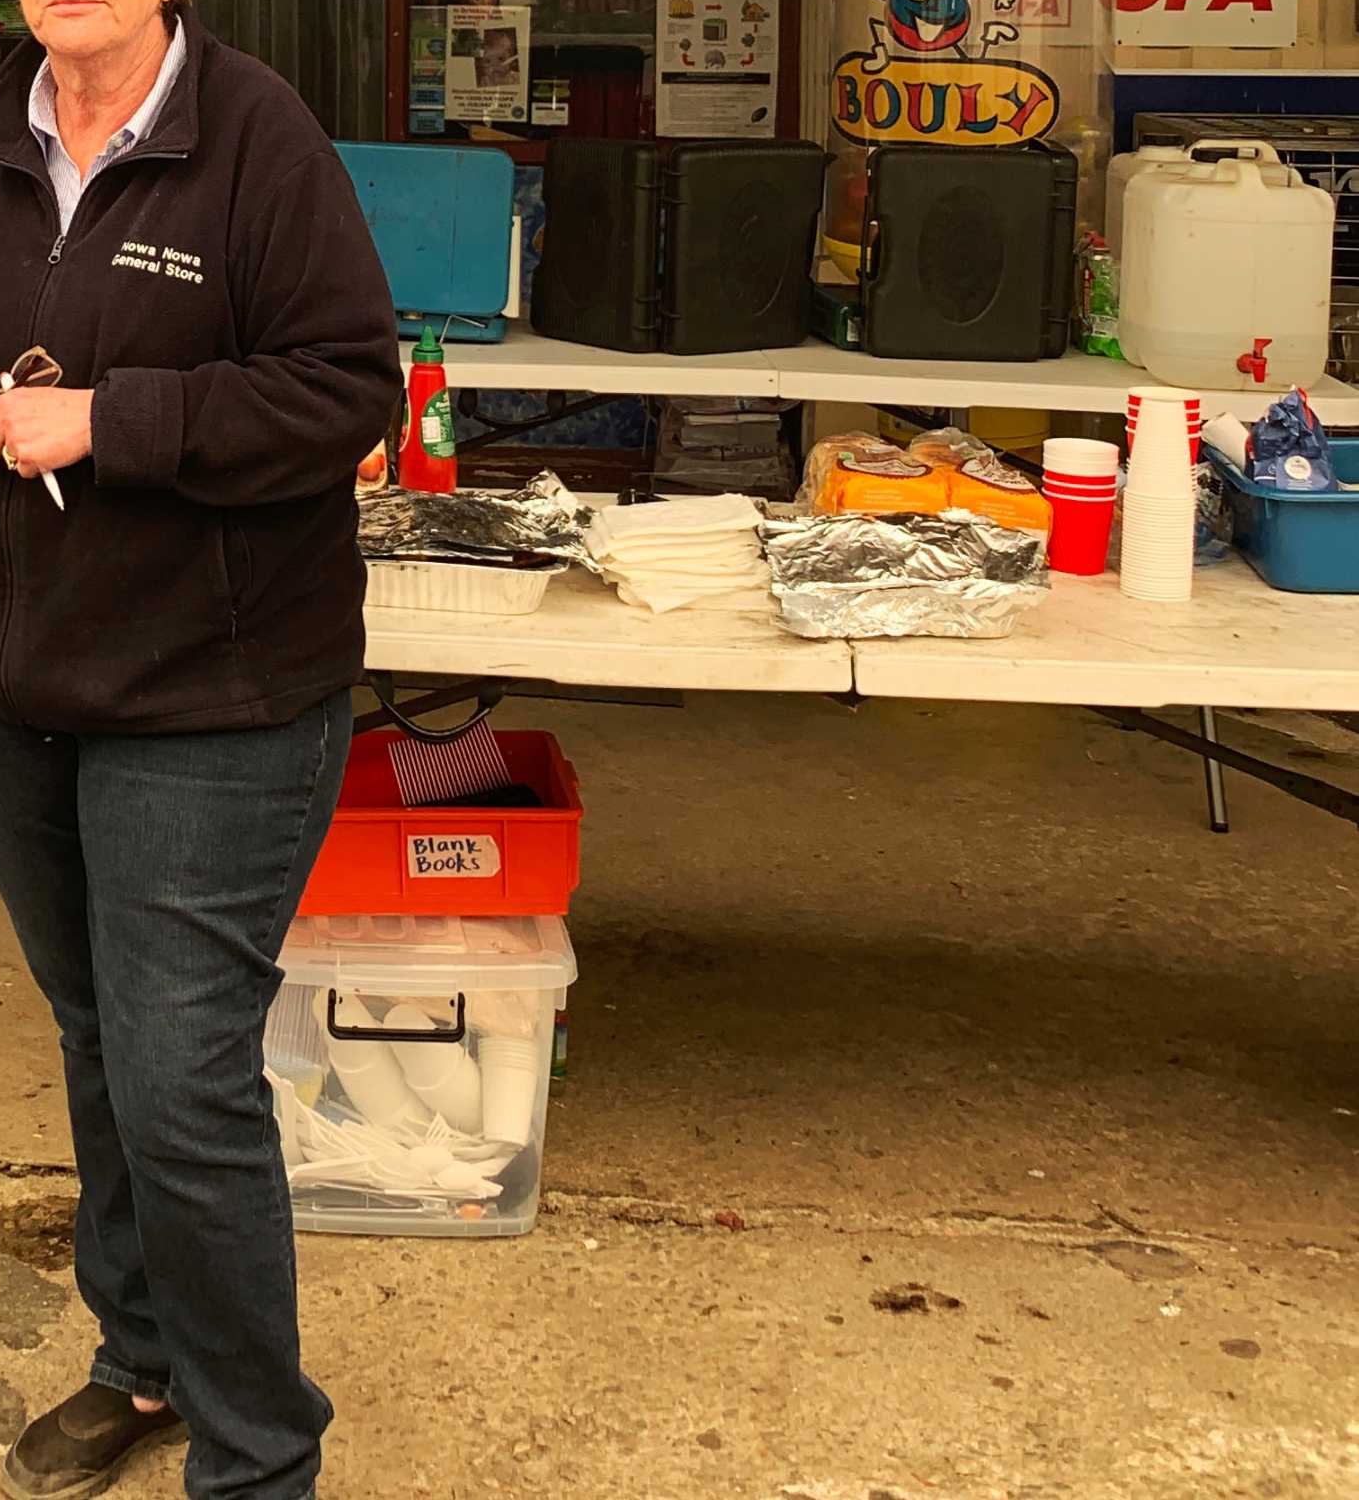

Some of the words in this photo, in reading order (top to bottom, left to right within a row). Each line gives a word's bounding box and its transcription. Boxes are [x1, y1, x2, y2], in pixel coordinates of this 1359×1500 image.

[837, 75, 1048, 136] BOULY
[121, 240, 156, 256] Nowa
[162, 247, 201, 266] Nowa
[111, 254, 160, 273] General
[165, 263, 204, 284] Store
[413, 837, 482, 855] Blank
[416, 852, 481, 873] Books
